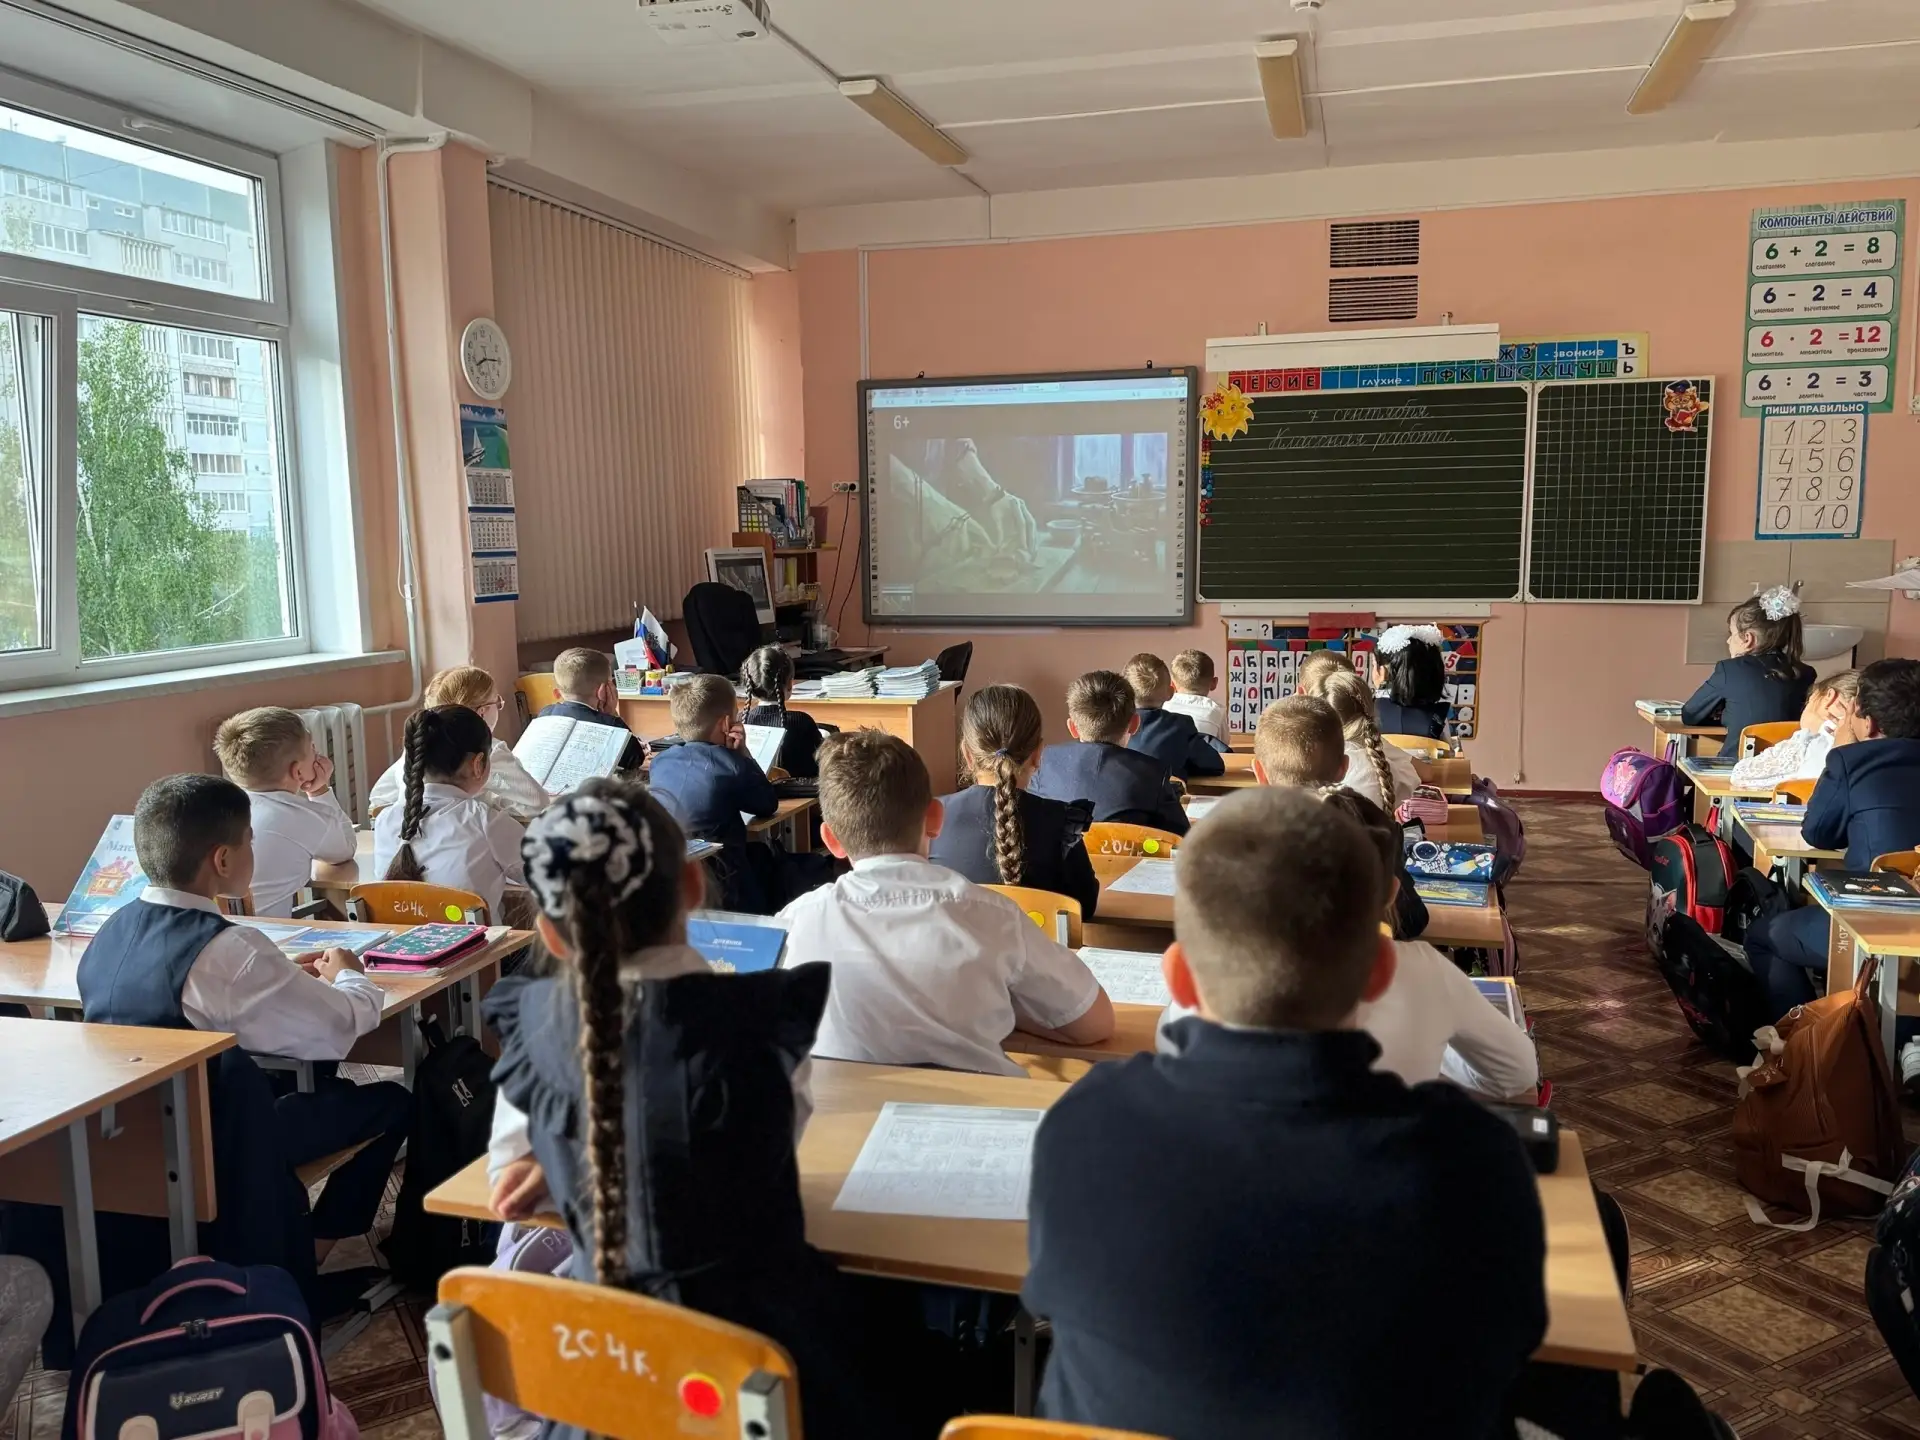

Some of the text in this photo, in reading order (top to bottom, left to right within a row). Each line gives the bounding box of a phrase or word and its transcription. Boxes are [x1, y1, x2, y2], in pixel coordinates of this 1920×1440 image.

[1760, 209, 1894, 229] КОМПОНЕНТЫ ДЕЙСТВИЙ
[1765, 237, 1880, 260] 6 + 2 = 8
[1756, 258, 1882, 270] слагаемое слагаемое сумма
[1763, 287, 1777, 304] 6
[1812, 285, 1825, 301] 2
[1841, 288, 1852, 296] =
[1863, 282, 1877, 298] 4
[1804, 304, 1840, 312] вычитаемое
[1856, 302, 1883, 310] разность
[1760, 331, 1774, 348] 6
[1809, 328, 1823, 345] 2
[1853, 326, 1881, 344] 12
[1500, 348, 1514, 361] Ж
[1521, 347, 1532, 359] З
[1553, 348, 1605, 359] звонкие
[1622, 343, 1636, 355] Ъ
[1847, 346, 1888, 354] произведение
[1251, 375, 1260, 390] Ё
[1267, 376, 1281, 389] Ю
[1288, 375, 1298, 388] И
[1306, 374, 1315, 387] Е
[1362, 376, 1403, 388] глухие
[1423, 369, 1434, 382] П
[1439, 368, 1454, 381] Ф
[1460, 367, 1472, 381] К
[1481, 367, 1491, 380] Т
[1497, 366, 1513, 379] Ш
[1517, 365, 1533, 379] С
[1539, 364, 1553, 377] Х
[1559, 363, 1574, 378] Ц
[1580, 362, 1592, 375] Ч
[1599, 360, 1616, 375] Щ
[1623, 362, 1633, 374] Ь
[1758, 375, 1772, 391] 6
[1807, 372, 1820, 389] 2
[1836, 376, 1847, 385] =
[1858, 370, 1872, 387] 3
[1309, 409, 1319, 423] 7
[1765, 403, 1864, 415] ПИШИ ПРАВИЛЬНО
[893, 414, 910, 430] 6+
[1268, 427, 1368, 450] Классная
[1784, 418, 1857, 445] 1 2 3
[1778, 447, 1855, 473] 4 5 6
[1776, 475, 1854, 502] 7 8 9
[1775, 505, 1791, 530] 0
[1261, 623, 1269, 636] ?
[1247, 655, 1257, 667] Б
[1445, 653, 1458, 668] 5
[1230, 672, 1242, 682] Ж
[1266, 671, 1276, 683] И
[1233, 686, 1242, 698] Н
[1248, 687, 1258, 699] О
[1230, 703, 1241, 713] Ф
[1230, 720, 1241, 729] Ы
